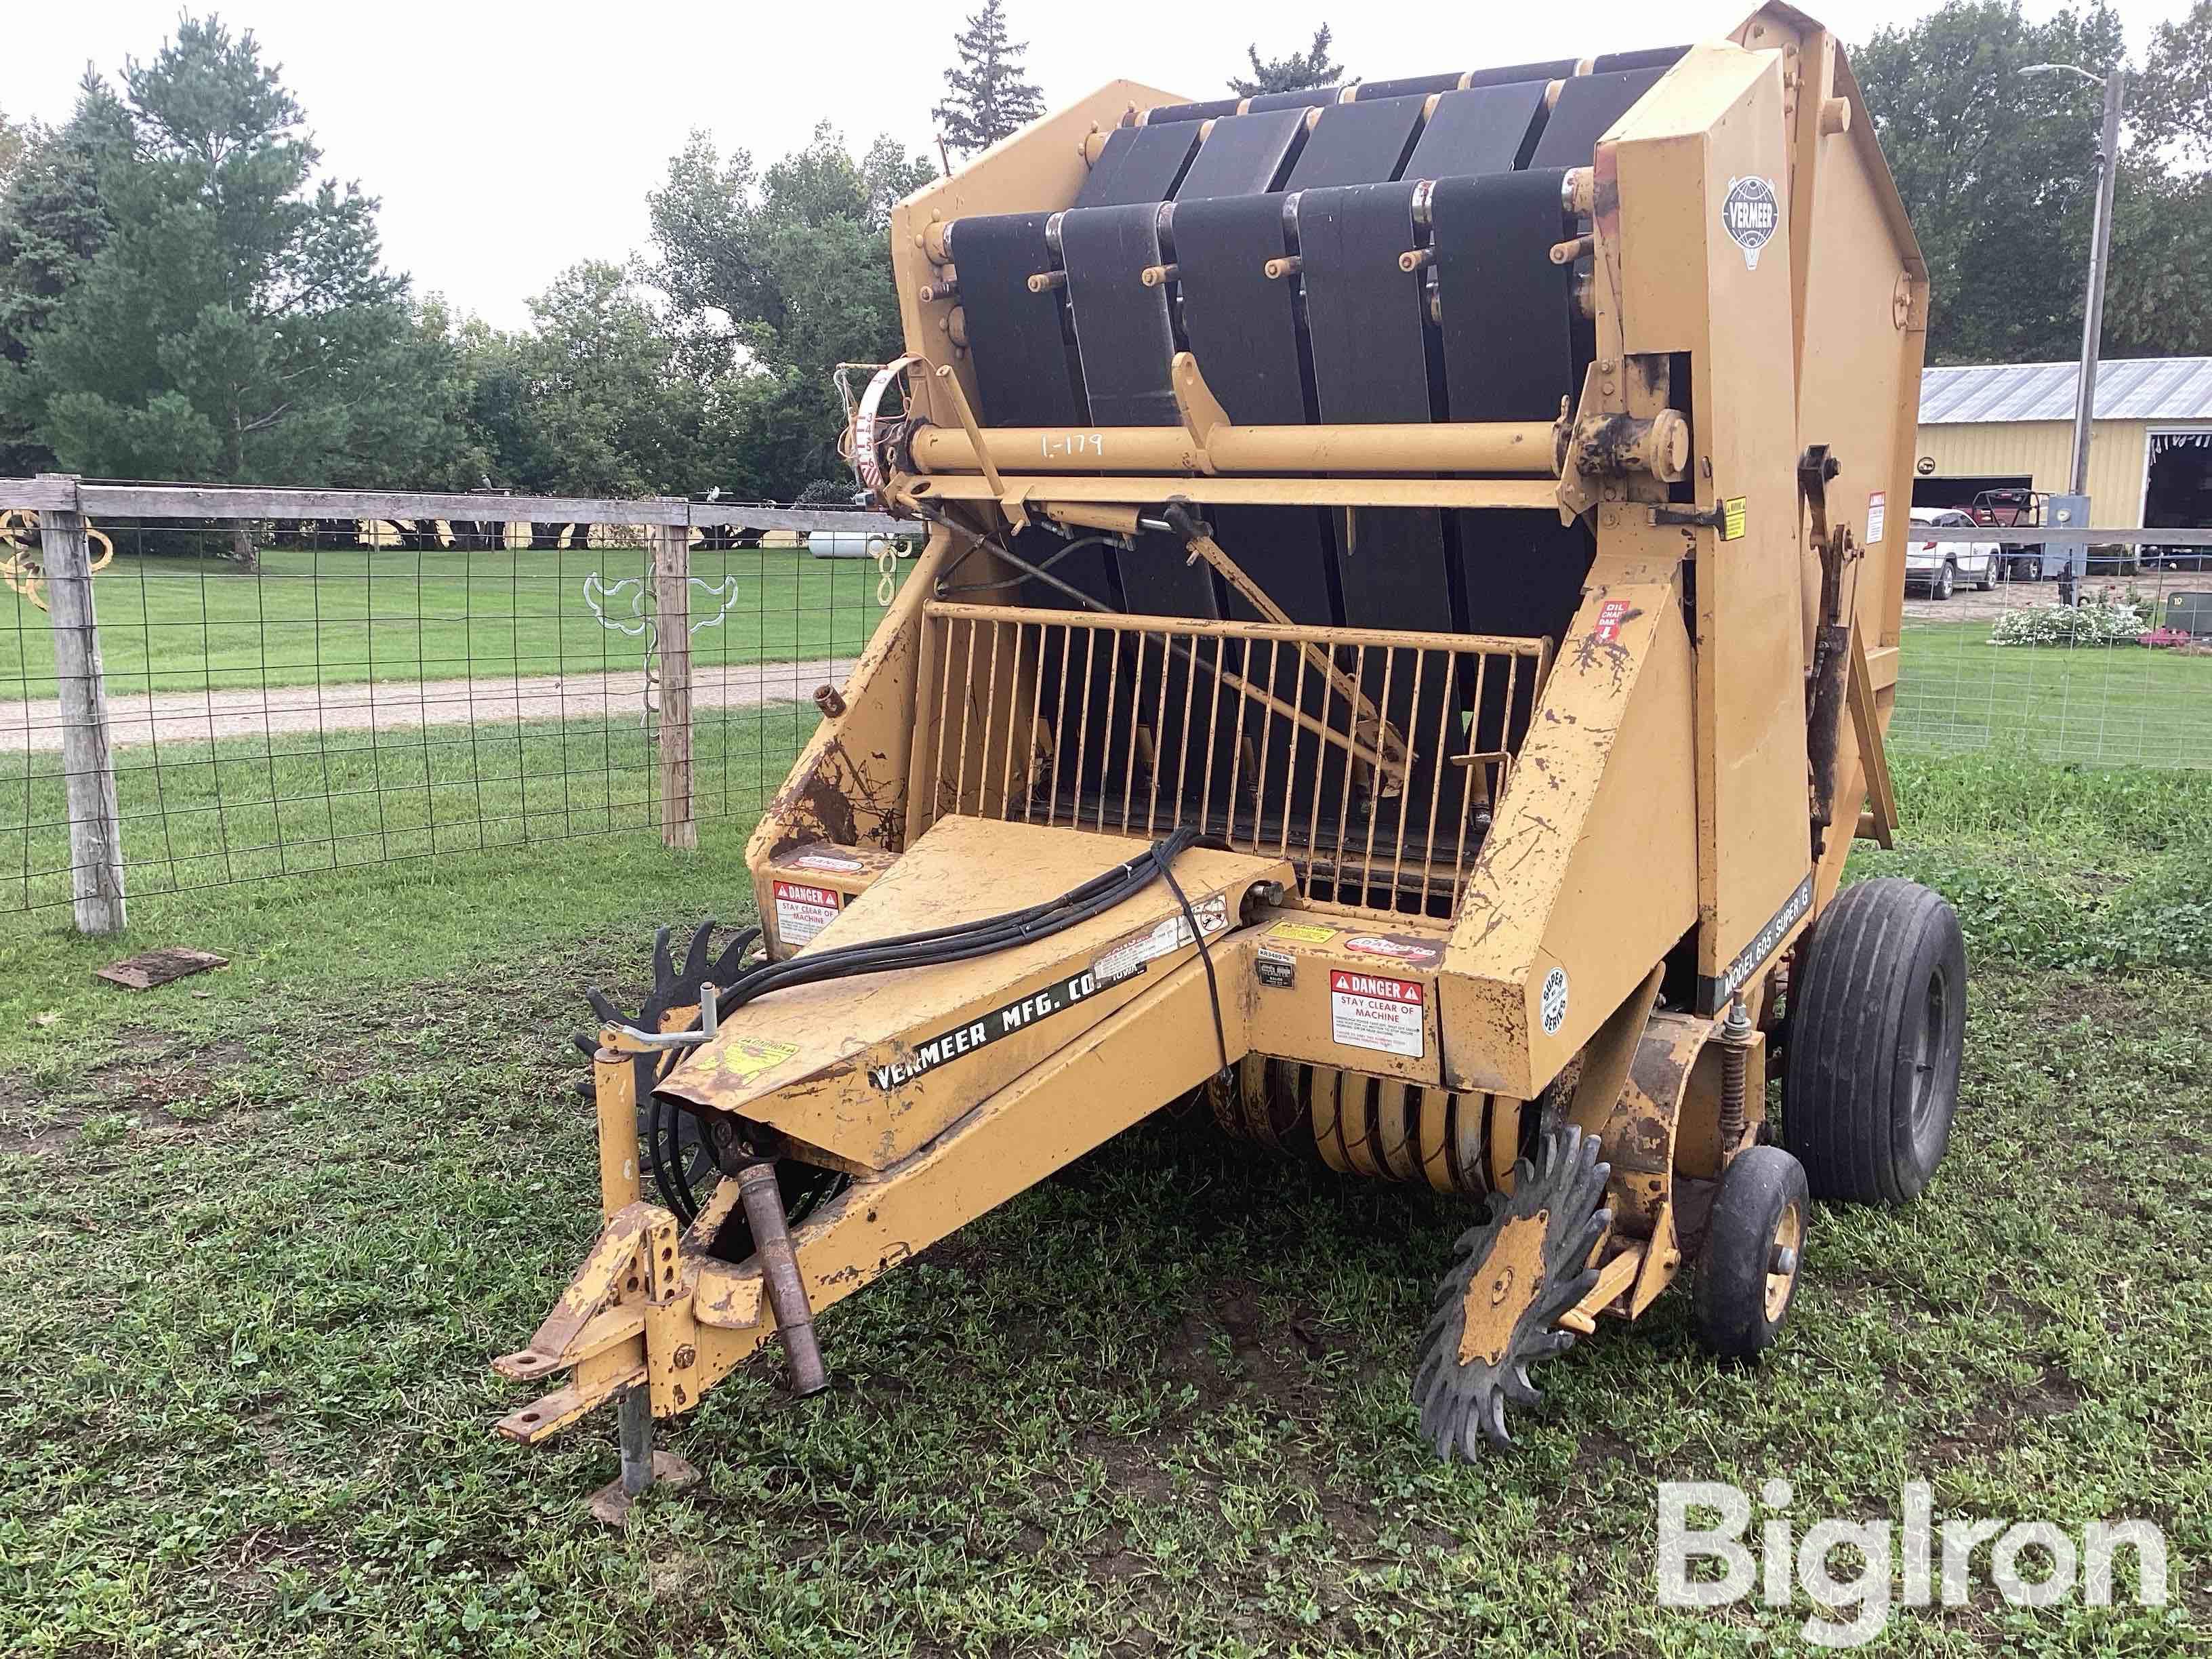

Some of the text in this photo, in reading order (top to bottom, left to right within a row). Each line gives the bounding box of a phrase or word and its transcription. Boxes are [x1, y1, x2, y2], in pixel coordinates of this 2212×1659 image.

[1729, 201, 1773, 228] VERMEER
[867, 412, 873, 423] 3
[868, 458, 875, 468] 6
[788, 885, 823, 904] DANGER
[782, 903, 799, 912] STAY
[802, 906, 822, 916] CLEAR
[793, 913, 825, 924] MACHINE
[1724, 953, 1755, 997] MODEL
[1757, 930, 1772, 961] 605
[1776, 898, 1799, 938] SUPER
[1352, 976, 1401, 999] DANGER
[1544, 972, 1563, 1002] SUPER
[1002, 993, 1061, 1031] MFG.
[1341, 996, 1414, 1015] STAY CLEAR OF
[1355, 1008, 1399, 1023] MACHINE
[1545, 1000, 1565, 1031] SERIES
